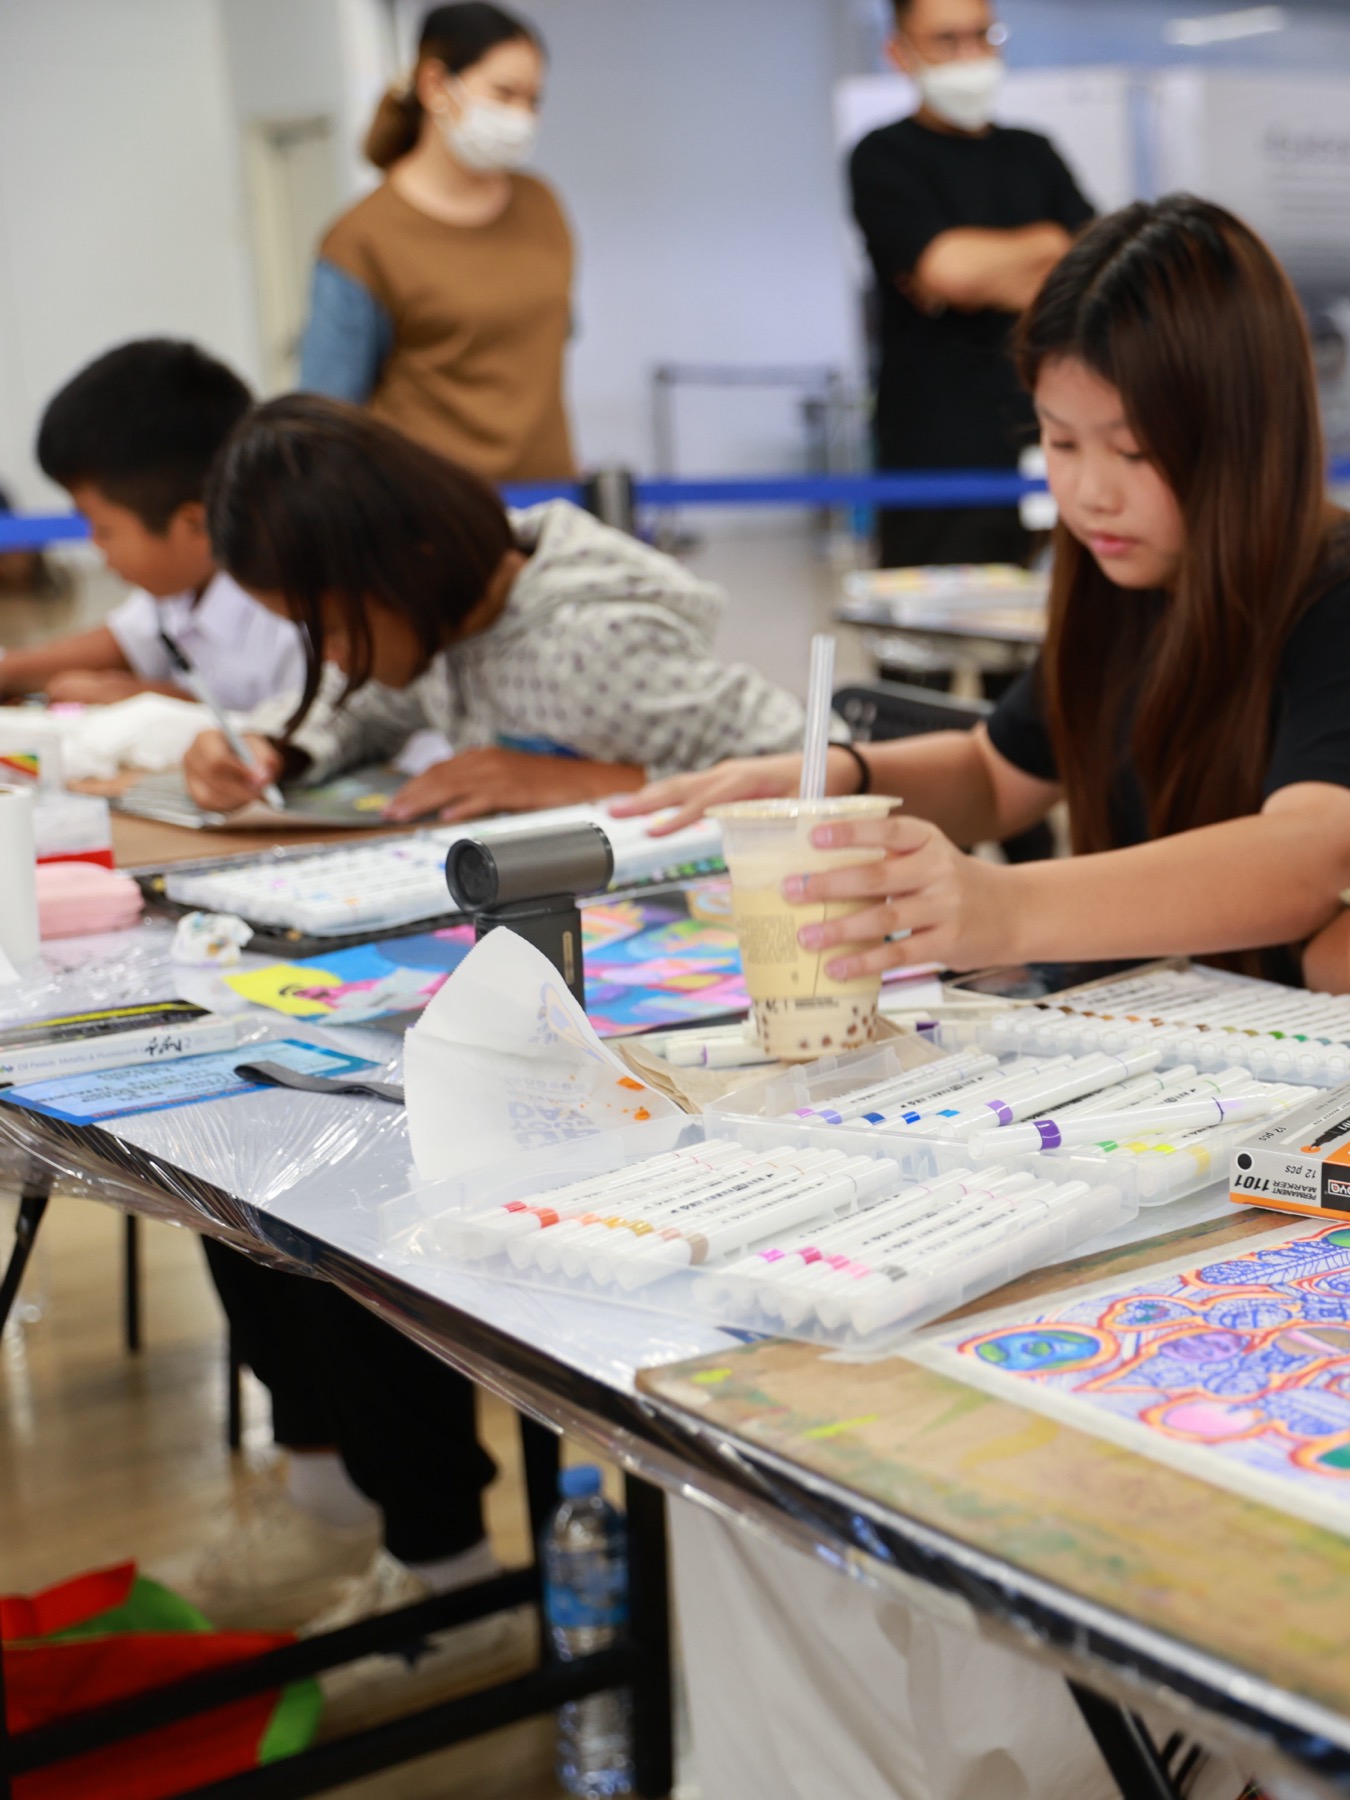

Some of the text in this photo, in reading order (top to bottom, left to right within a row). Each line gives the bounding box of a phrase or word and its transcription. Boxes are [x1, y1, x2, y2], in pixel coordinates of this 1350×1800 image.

[1258, 1126, 1286, 1141] 12 pcs
[1285, 1165, 1317, 1179] 12 pcs
[1234, 1174, 1317, 1193] MARKER 1101
[1272, 1187, 1317, 1201] PERMANENT
